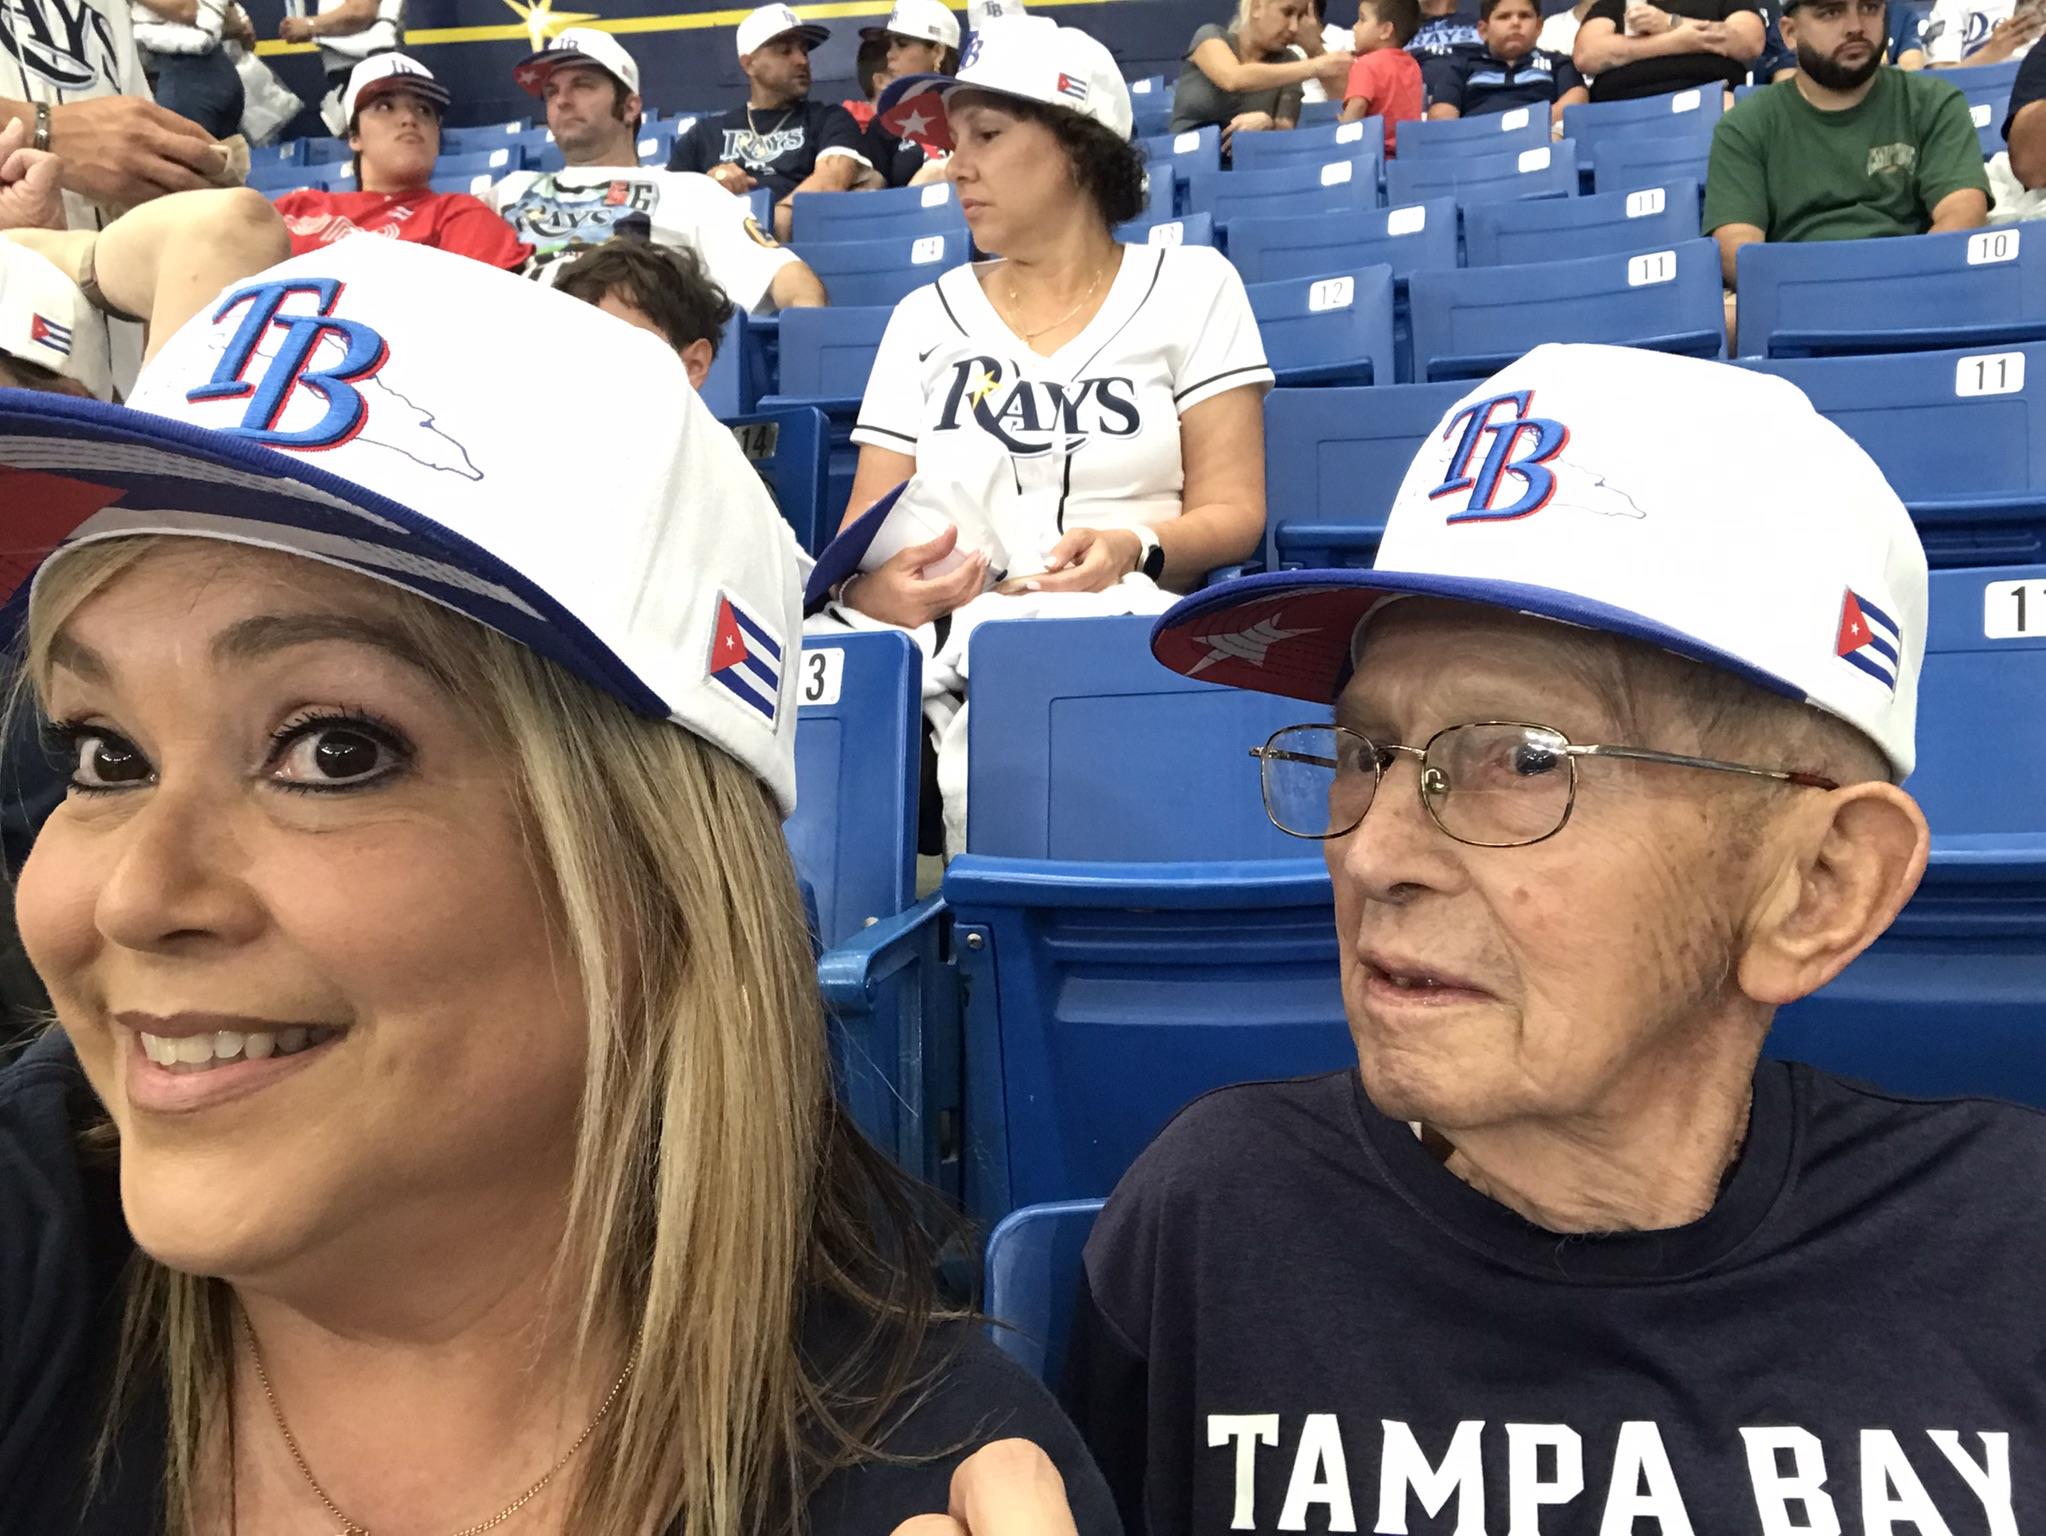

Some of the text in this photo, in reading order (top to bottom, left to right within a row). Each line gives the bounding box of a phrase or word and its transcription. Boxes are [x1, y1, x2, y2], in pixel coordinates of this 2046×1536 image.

[1982, 234, 2007, 259] 10
[1643, 256, 1664, 280] 11
[1322, 281, 1343, 305] 12
[185, 276, 391, 452] TB
[1975, 358, 2007, 390] 11
[932, 355, 1143, 456] RAYS
[741, 424, 769, 458] 14
[1428, 389, 1571, 526] TB
[2011, 585, 2046, 632] 1
[1207, 1413, 2021, 1536] TAMPA BAY
